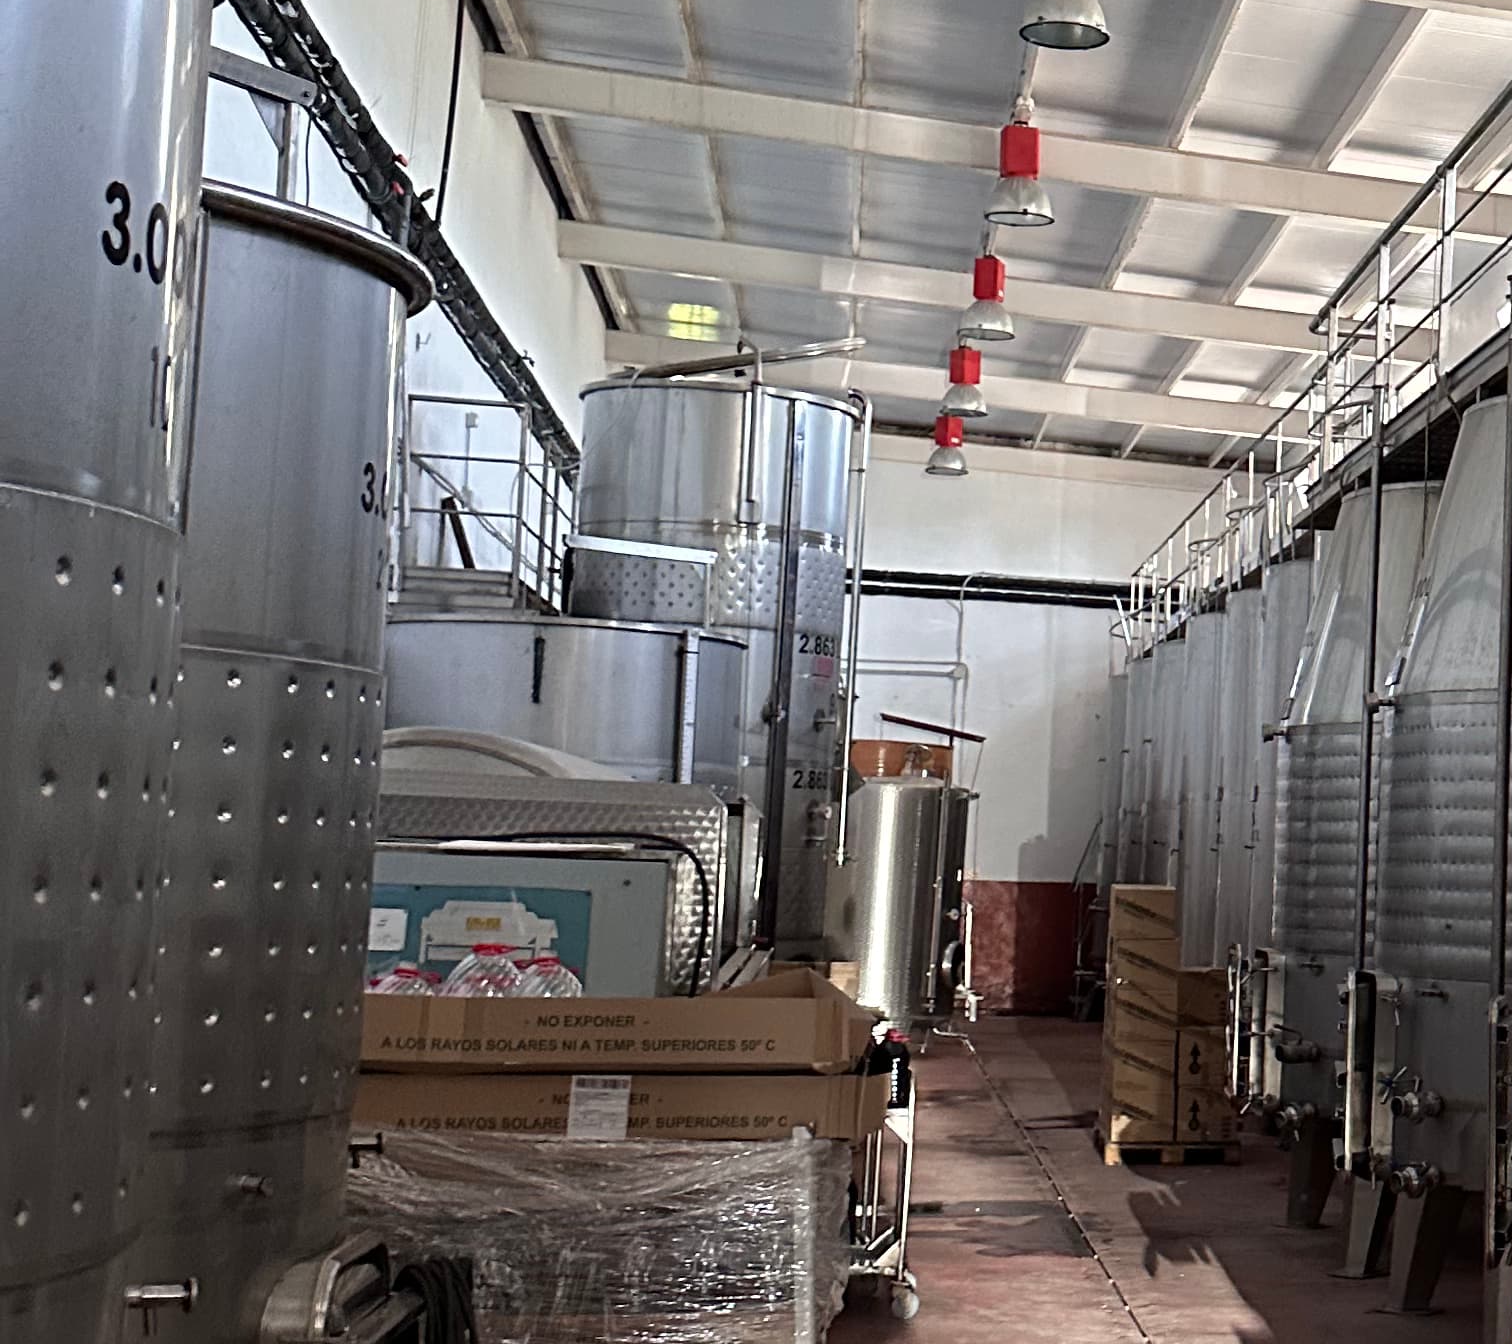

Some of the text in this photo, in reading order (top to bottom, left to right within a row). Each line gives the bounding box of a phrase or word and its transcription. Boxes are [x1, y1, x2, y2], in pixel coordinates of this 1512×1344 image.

[537, 1015, 636, 1028] NO EXPONER
[382, 1036, 392, 1049] A
[395, 1037, 427, 1050] LOS
[431, 1038, 482, 1052] RAYOS
[485, 1039, 558, 1052] SOLARES
[562, 1040, 577, 1052] NI
[580, 1040, 591, 1052] A
[641, 1039, 737, 1052] SUPERIORES
[766, 1039, 776, 1051] C
[395, 1118, 406, 1128] A
[410, 1118, 441, 1129] LOS
[445, 1117, 496, 1130] RAYOS
[628, 1117, 652, 1129] MP.
[655, 1116, 749, 1129] SUPERIORES
[778, 1116, 788, 1128] C
